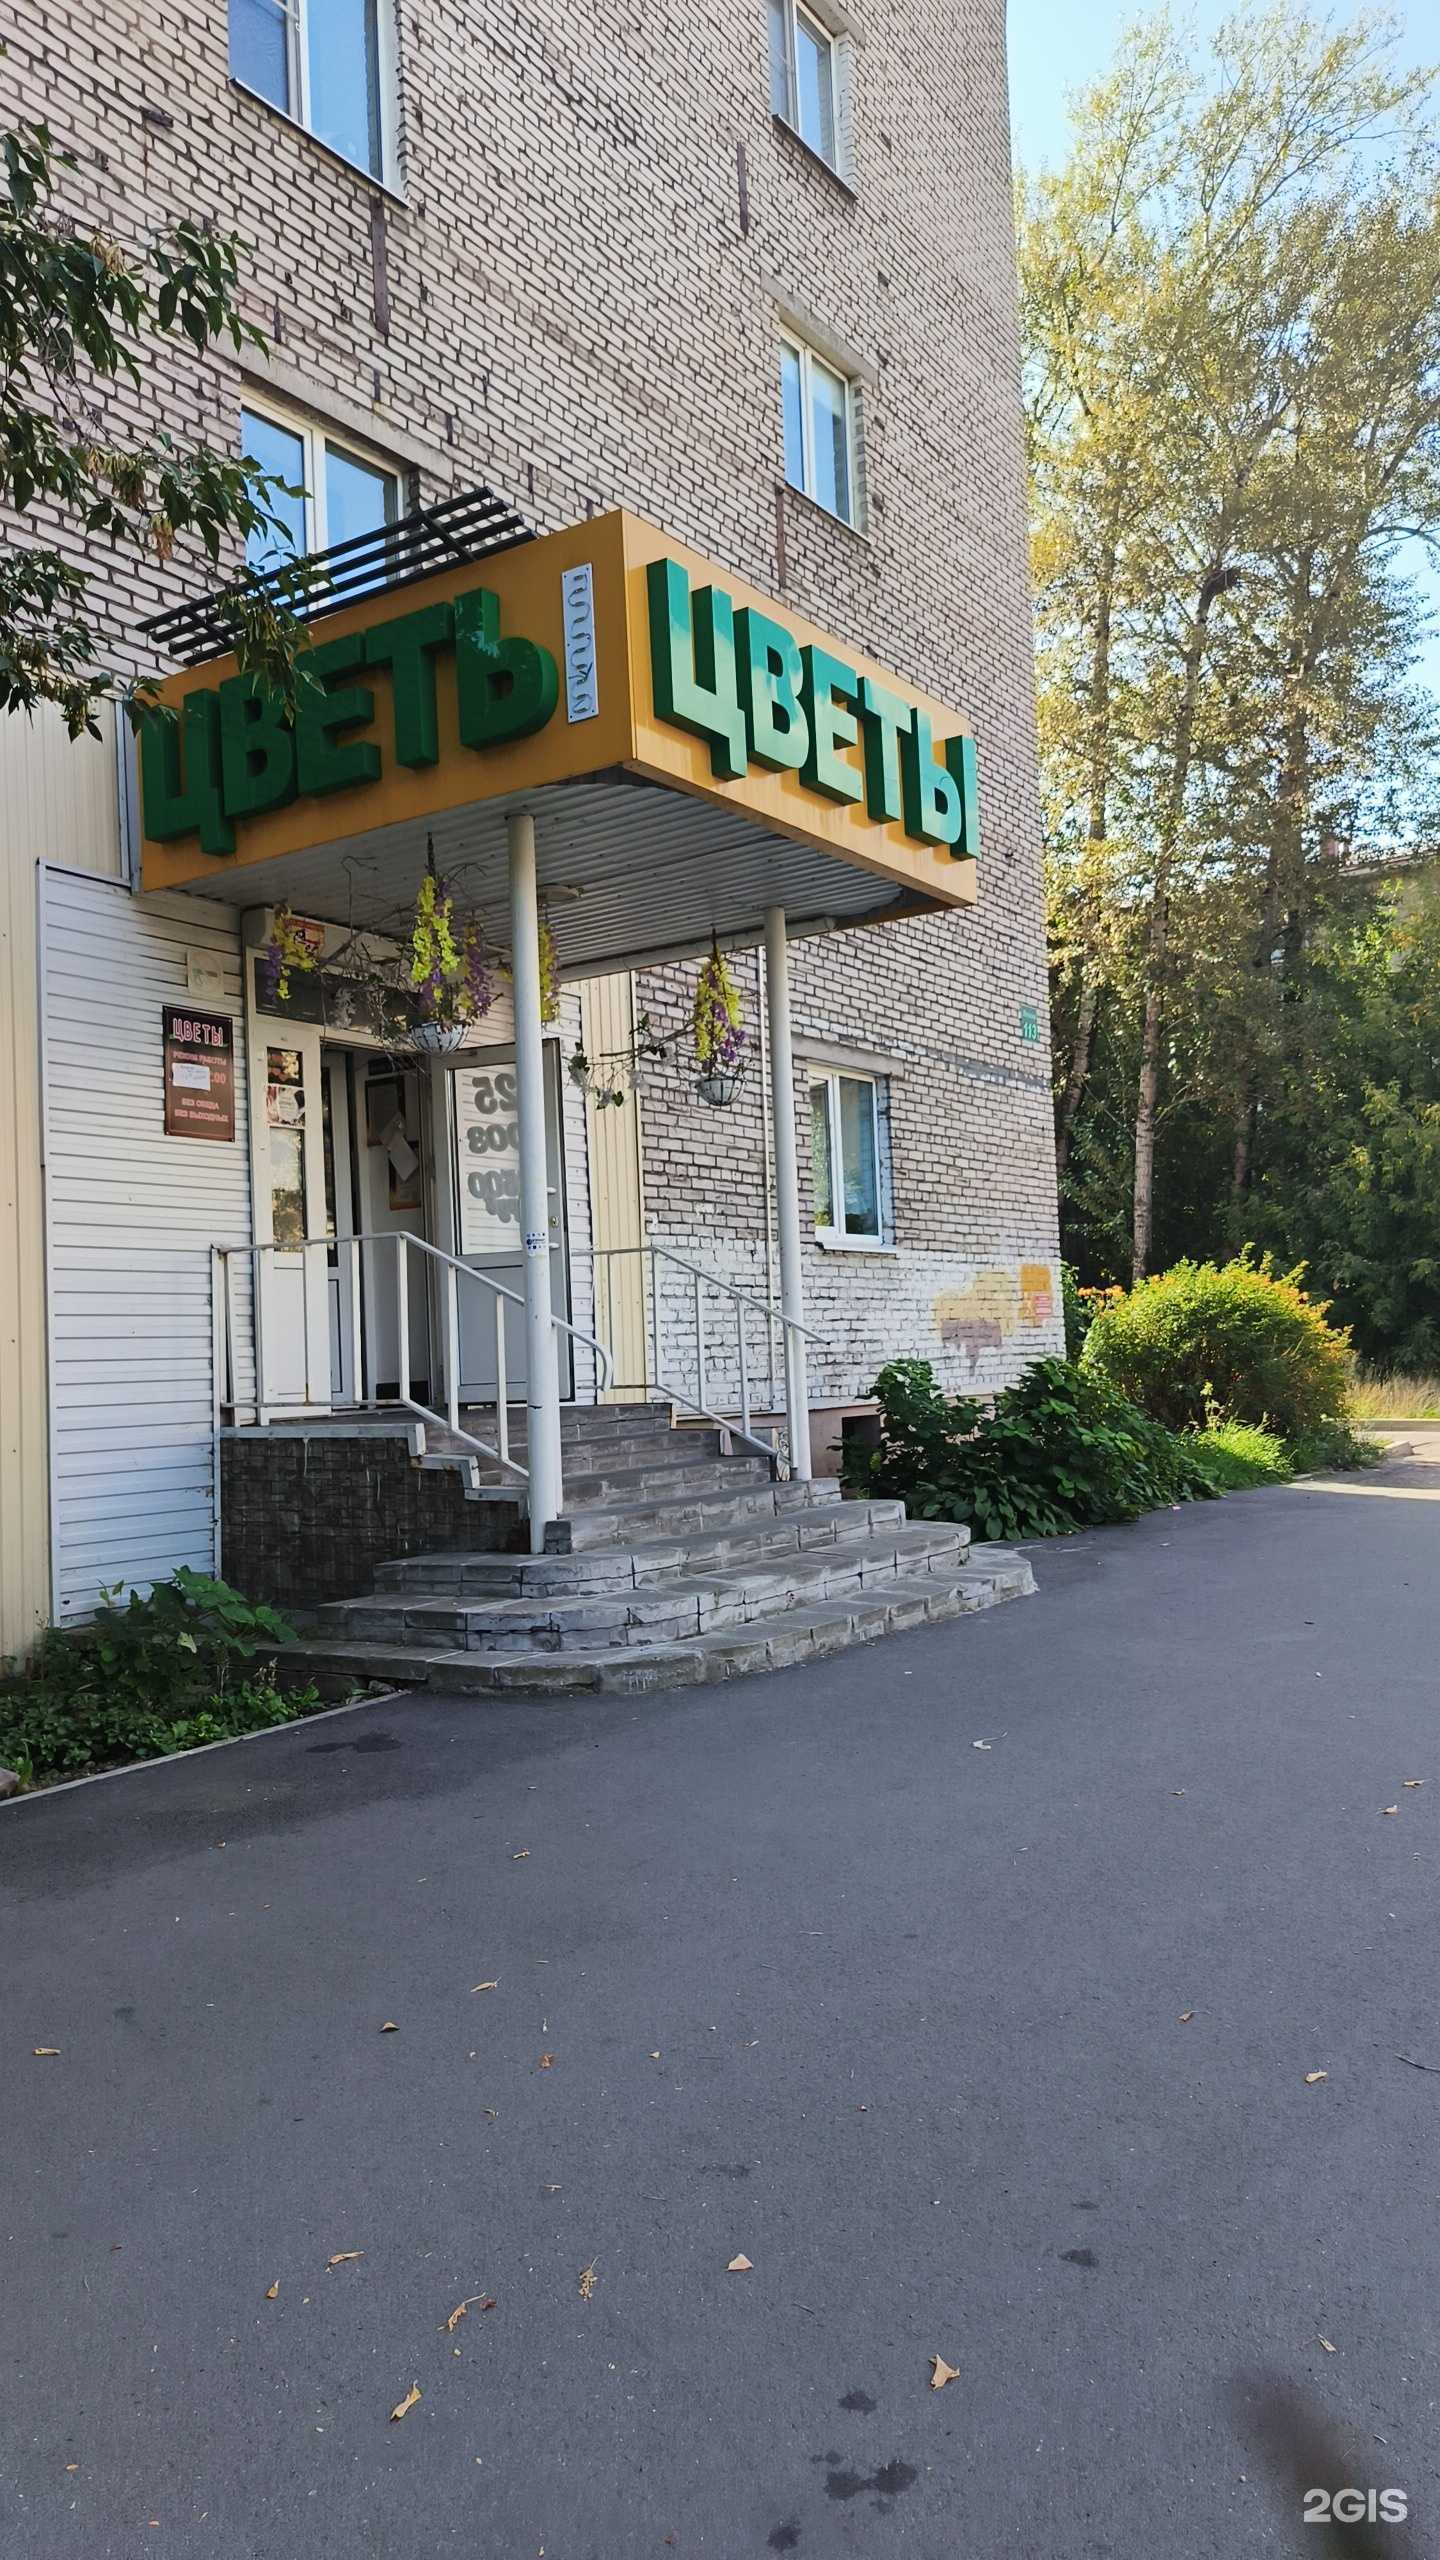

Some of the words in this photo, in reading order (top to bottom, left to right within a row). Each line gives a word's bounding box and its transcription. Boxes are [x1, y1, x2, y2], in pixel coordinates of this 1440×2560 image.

[646, 557, 977, 860] ЦВЕТЫ
[173, 1018, 223, 1047] ЦВЕТЫ
[1023, 1022, 1037, 1040] 113
